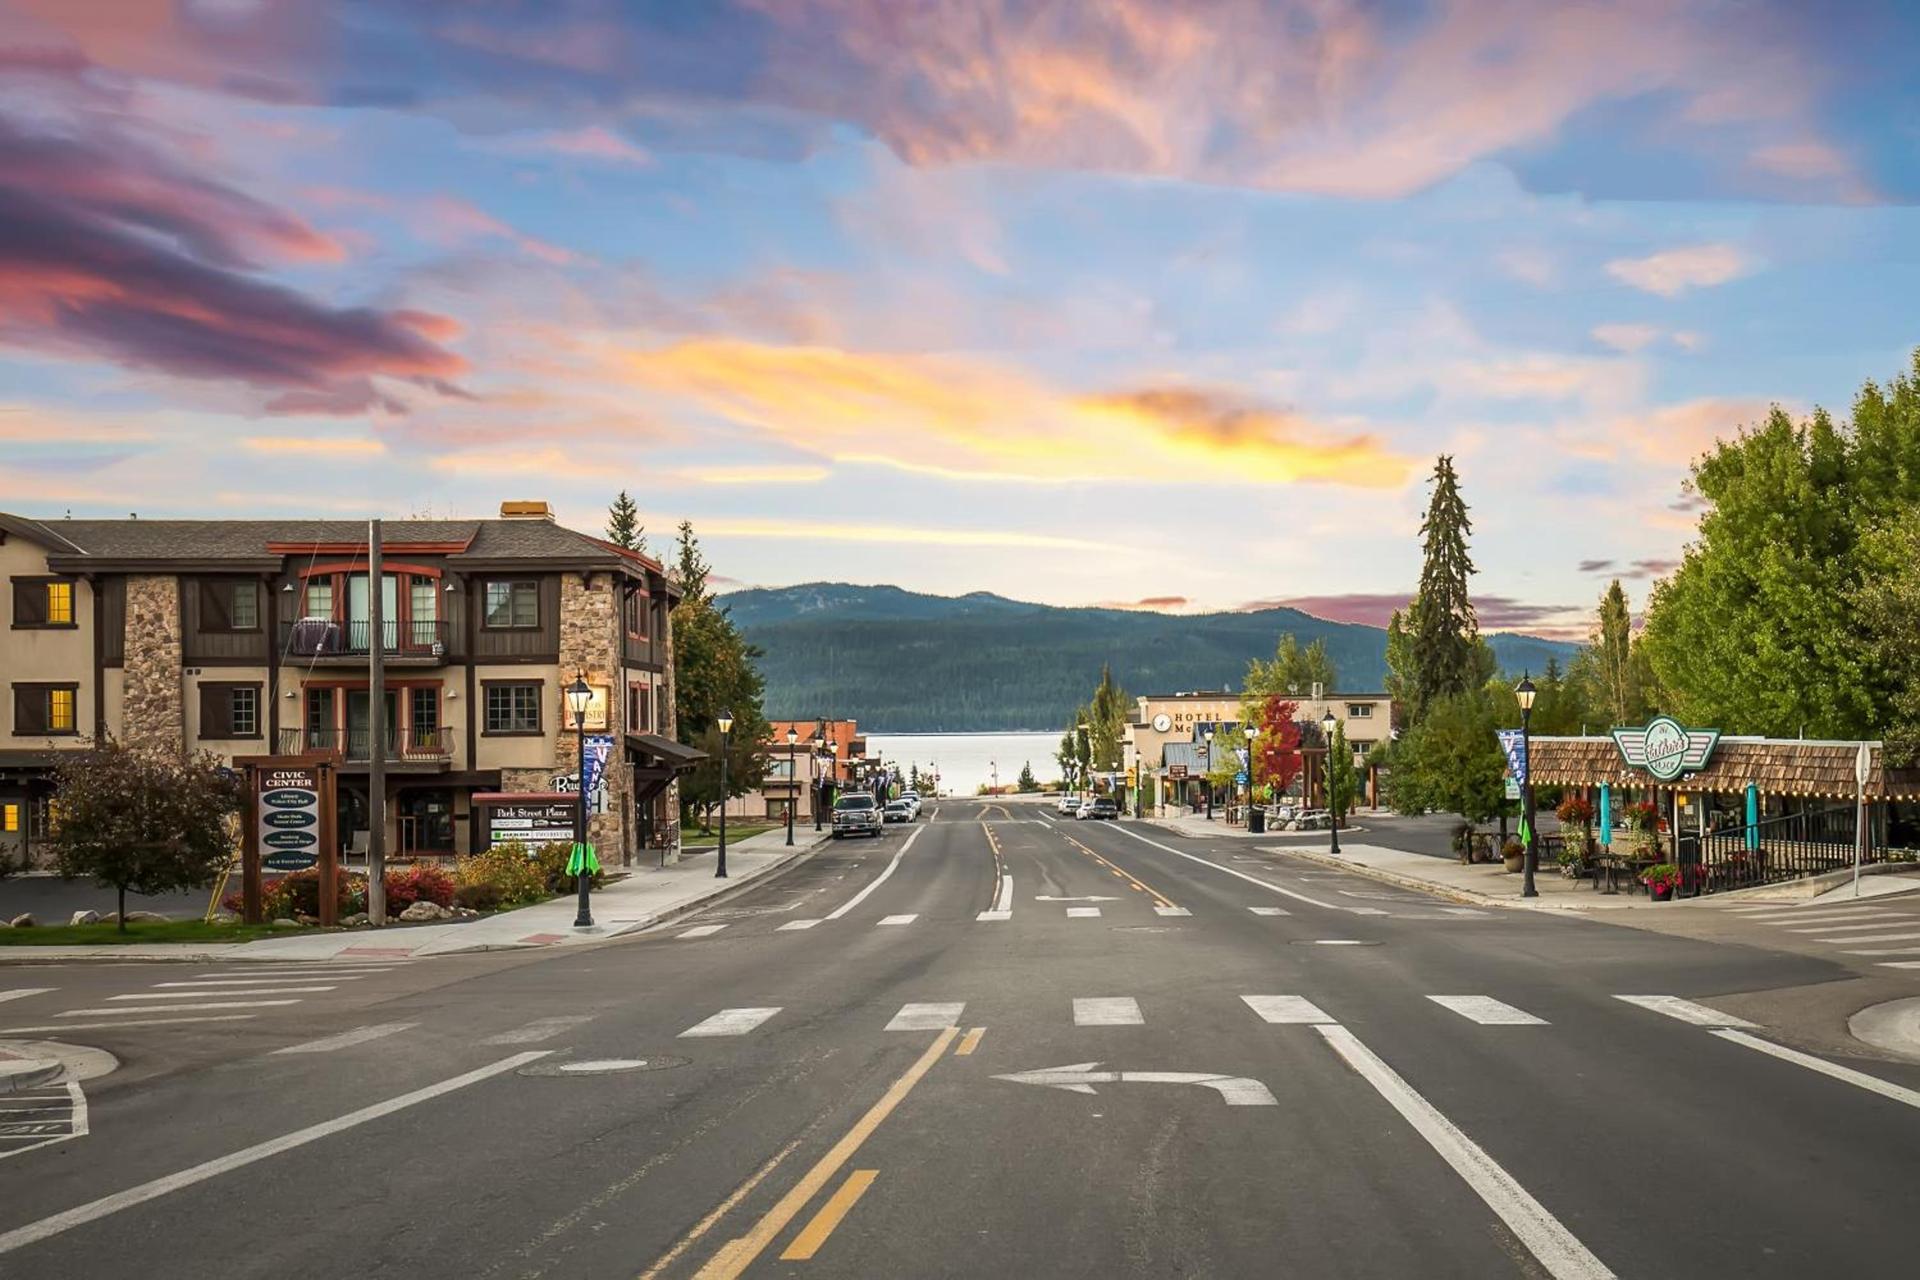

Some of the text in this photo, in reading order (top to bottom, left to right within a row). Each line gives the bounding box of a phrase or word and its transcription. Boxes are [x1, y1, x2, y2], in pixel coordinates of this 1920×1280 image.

[1175, 713, 1222, 722] HOTEL
[1175, 725, 1192, 733] Mc
[273, 771, 306, 779] CIVIC
[265, 779, 313, 787] CENTER
[497, 807, 568, 818] Park Street Plaza
